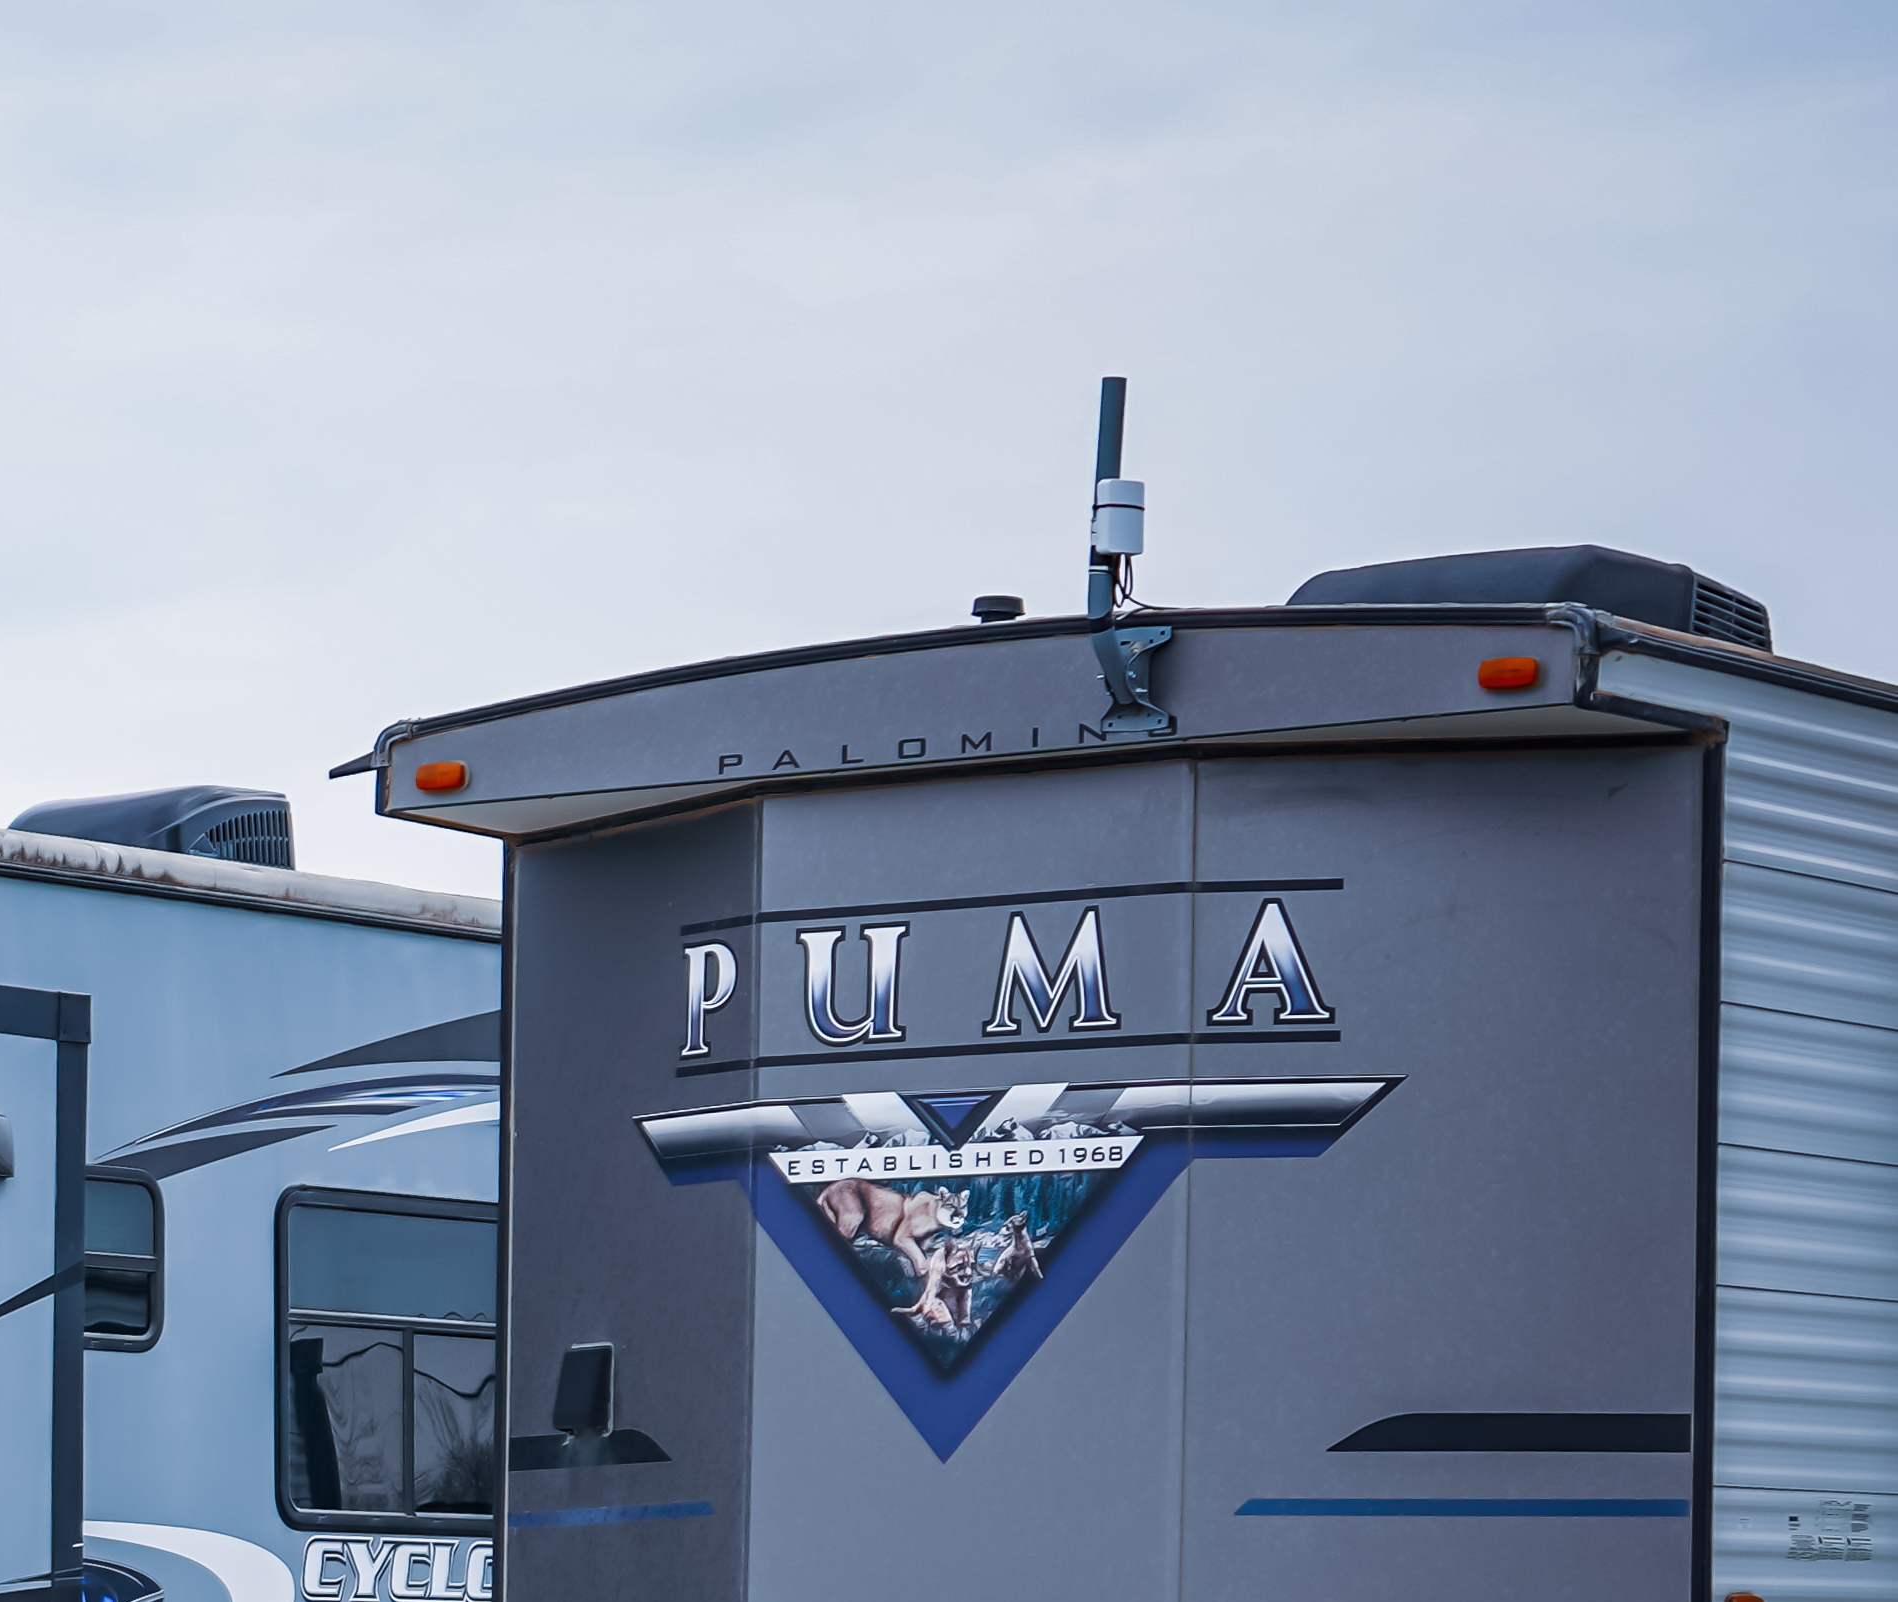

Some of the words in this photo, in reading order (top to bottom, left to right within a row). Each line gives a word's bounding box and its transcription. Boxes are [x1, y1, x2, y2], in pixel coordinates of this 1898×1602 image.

[679, 897, 1337, 1060] PUMA
[787, 1149, 1046, 1176] ESTABLISHED
[1058, 1145, 1125, 1164] 1968
